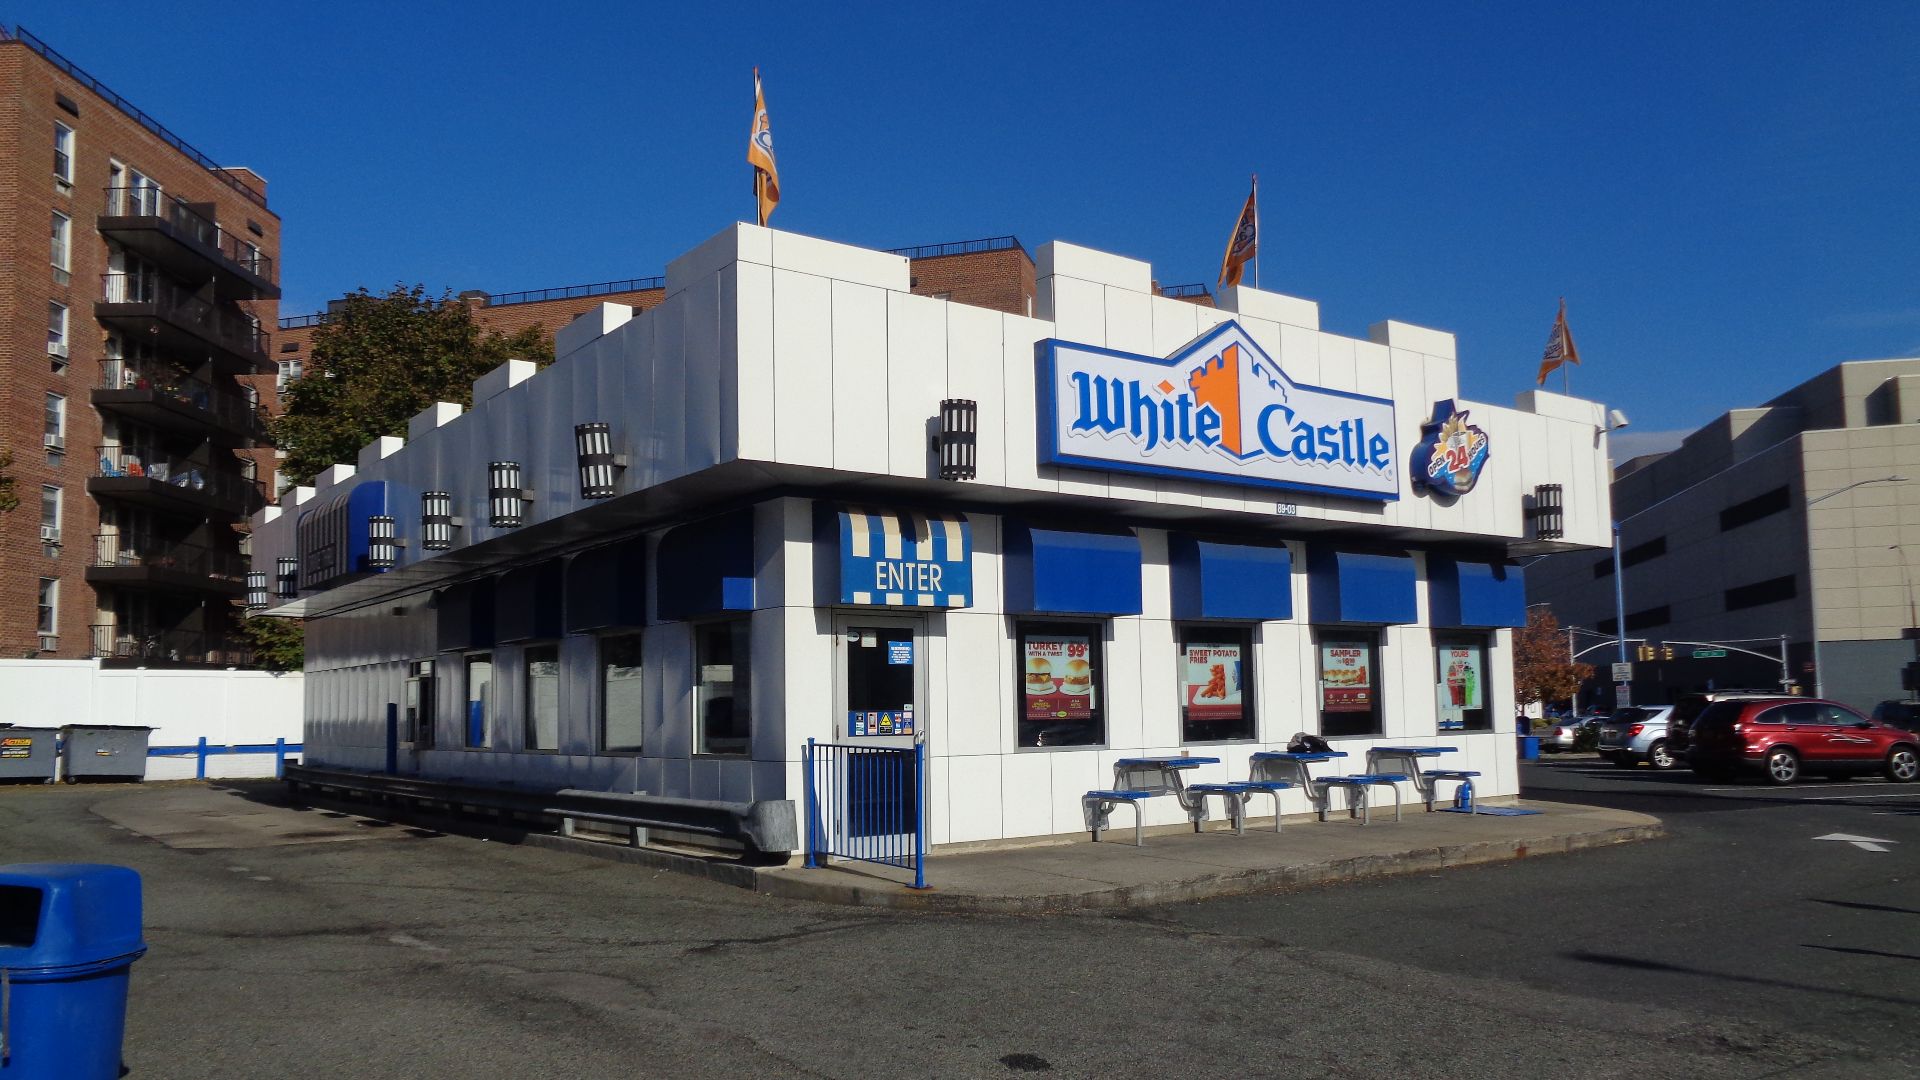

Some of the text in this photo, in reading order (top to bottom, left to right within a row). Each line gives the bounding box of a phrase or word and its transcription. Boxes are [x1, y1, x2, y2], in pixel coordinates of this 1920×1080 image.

[1071, 370, 1390, 471] White Castle
[1429, 457, 1445, 475] OPEN
[1446, 445, 1469, 472] 24
[1277, 503, 1296, 515] 89-03
[876, 561, 942, 592] ENTER
[1027, 641, 1063, 650] TURKEY
[1330, 649, 1361, 657] SAMPLER
[1450, 650, 1469, 658] YOURS
[1189, 656, 1208, 664] FRIES
[1, 737, 32, 746] ACTION
